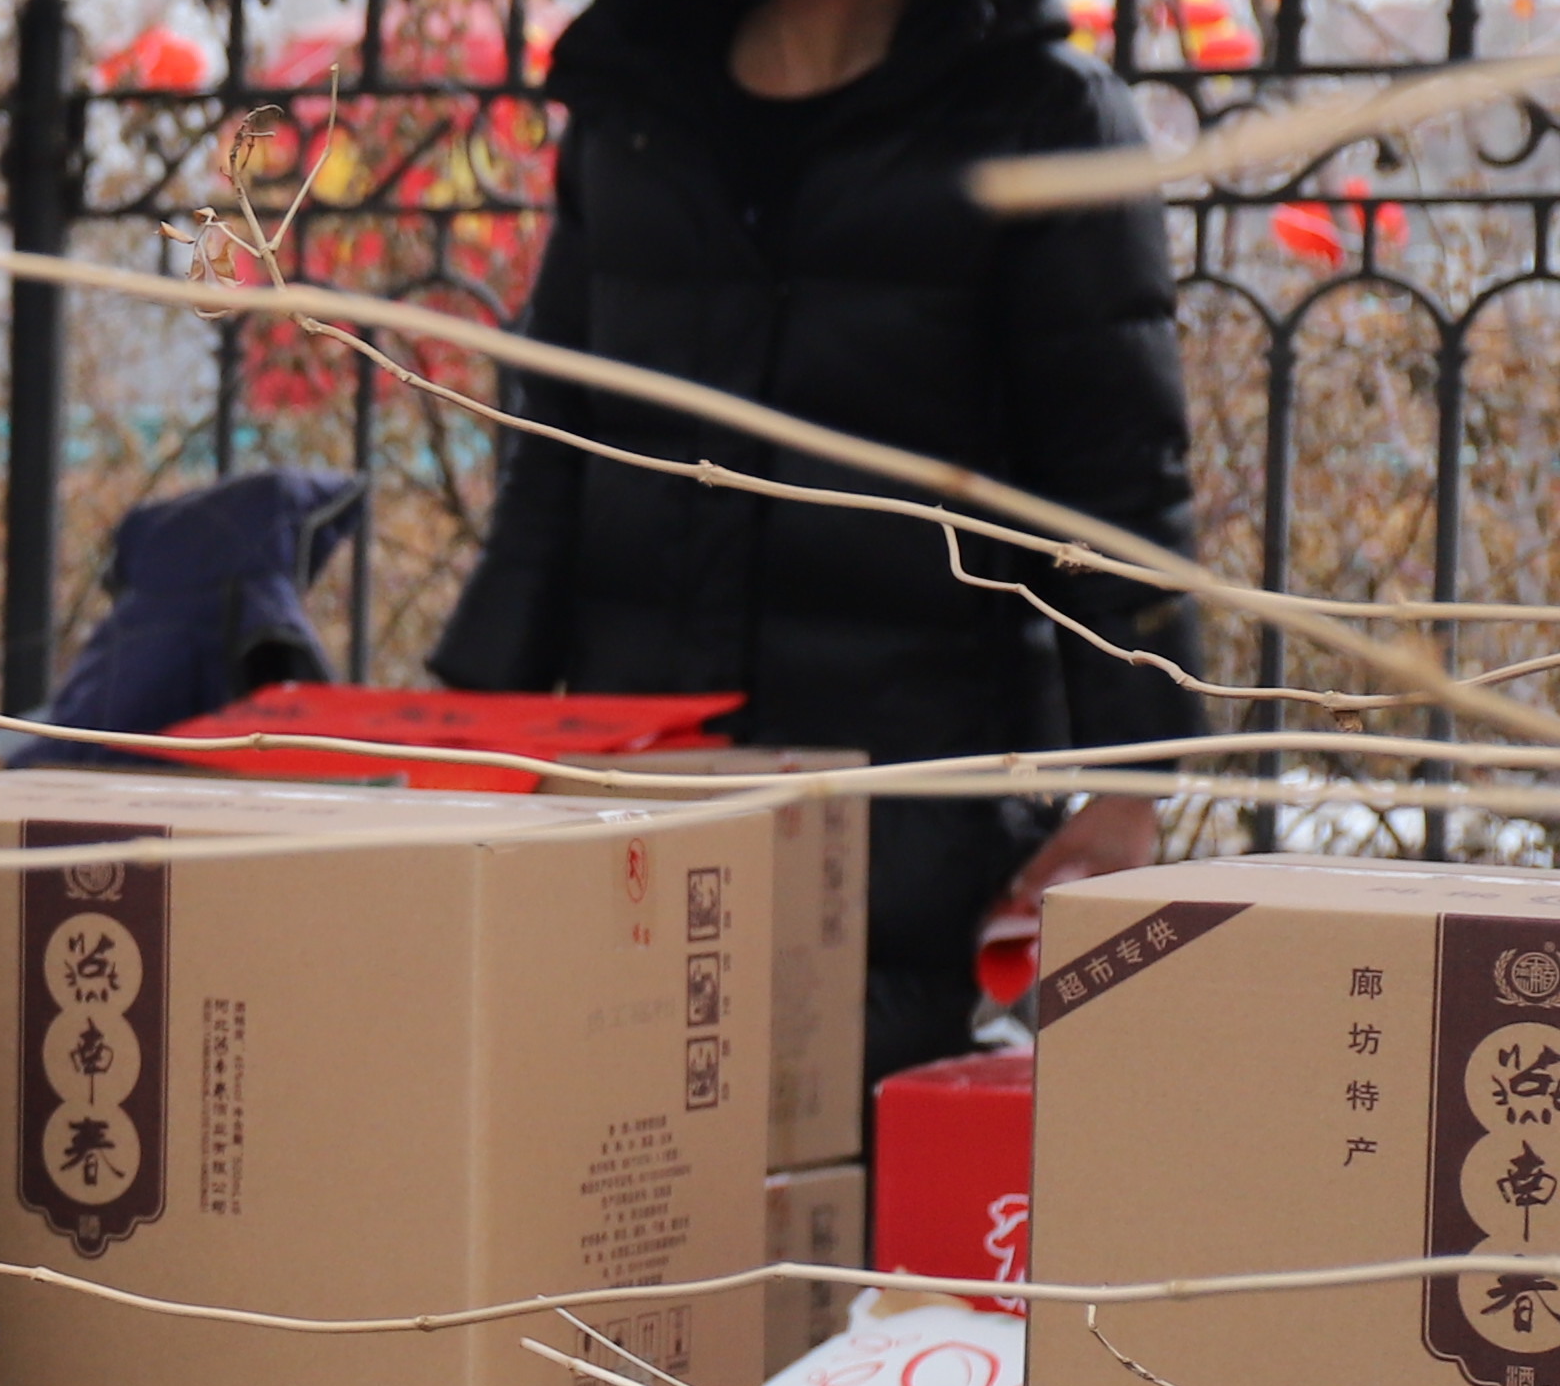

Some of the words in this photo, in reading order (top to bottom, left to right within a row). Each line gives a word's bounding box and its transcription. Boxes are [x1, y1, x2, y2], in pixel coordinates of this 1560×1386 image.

[1056, 917, 1179, 1004] 超市专供
[1343, 965, 1385, 1168] 廊坊特产
